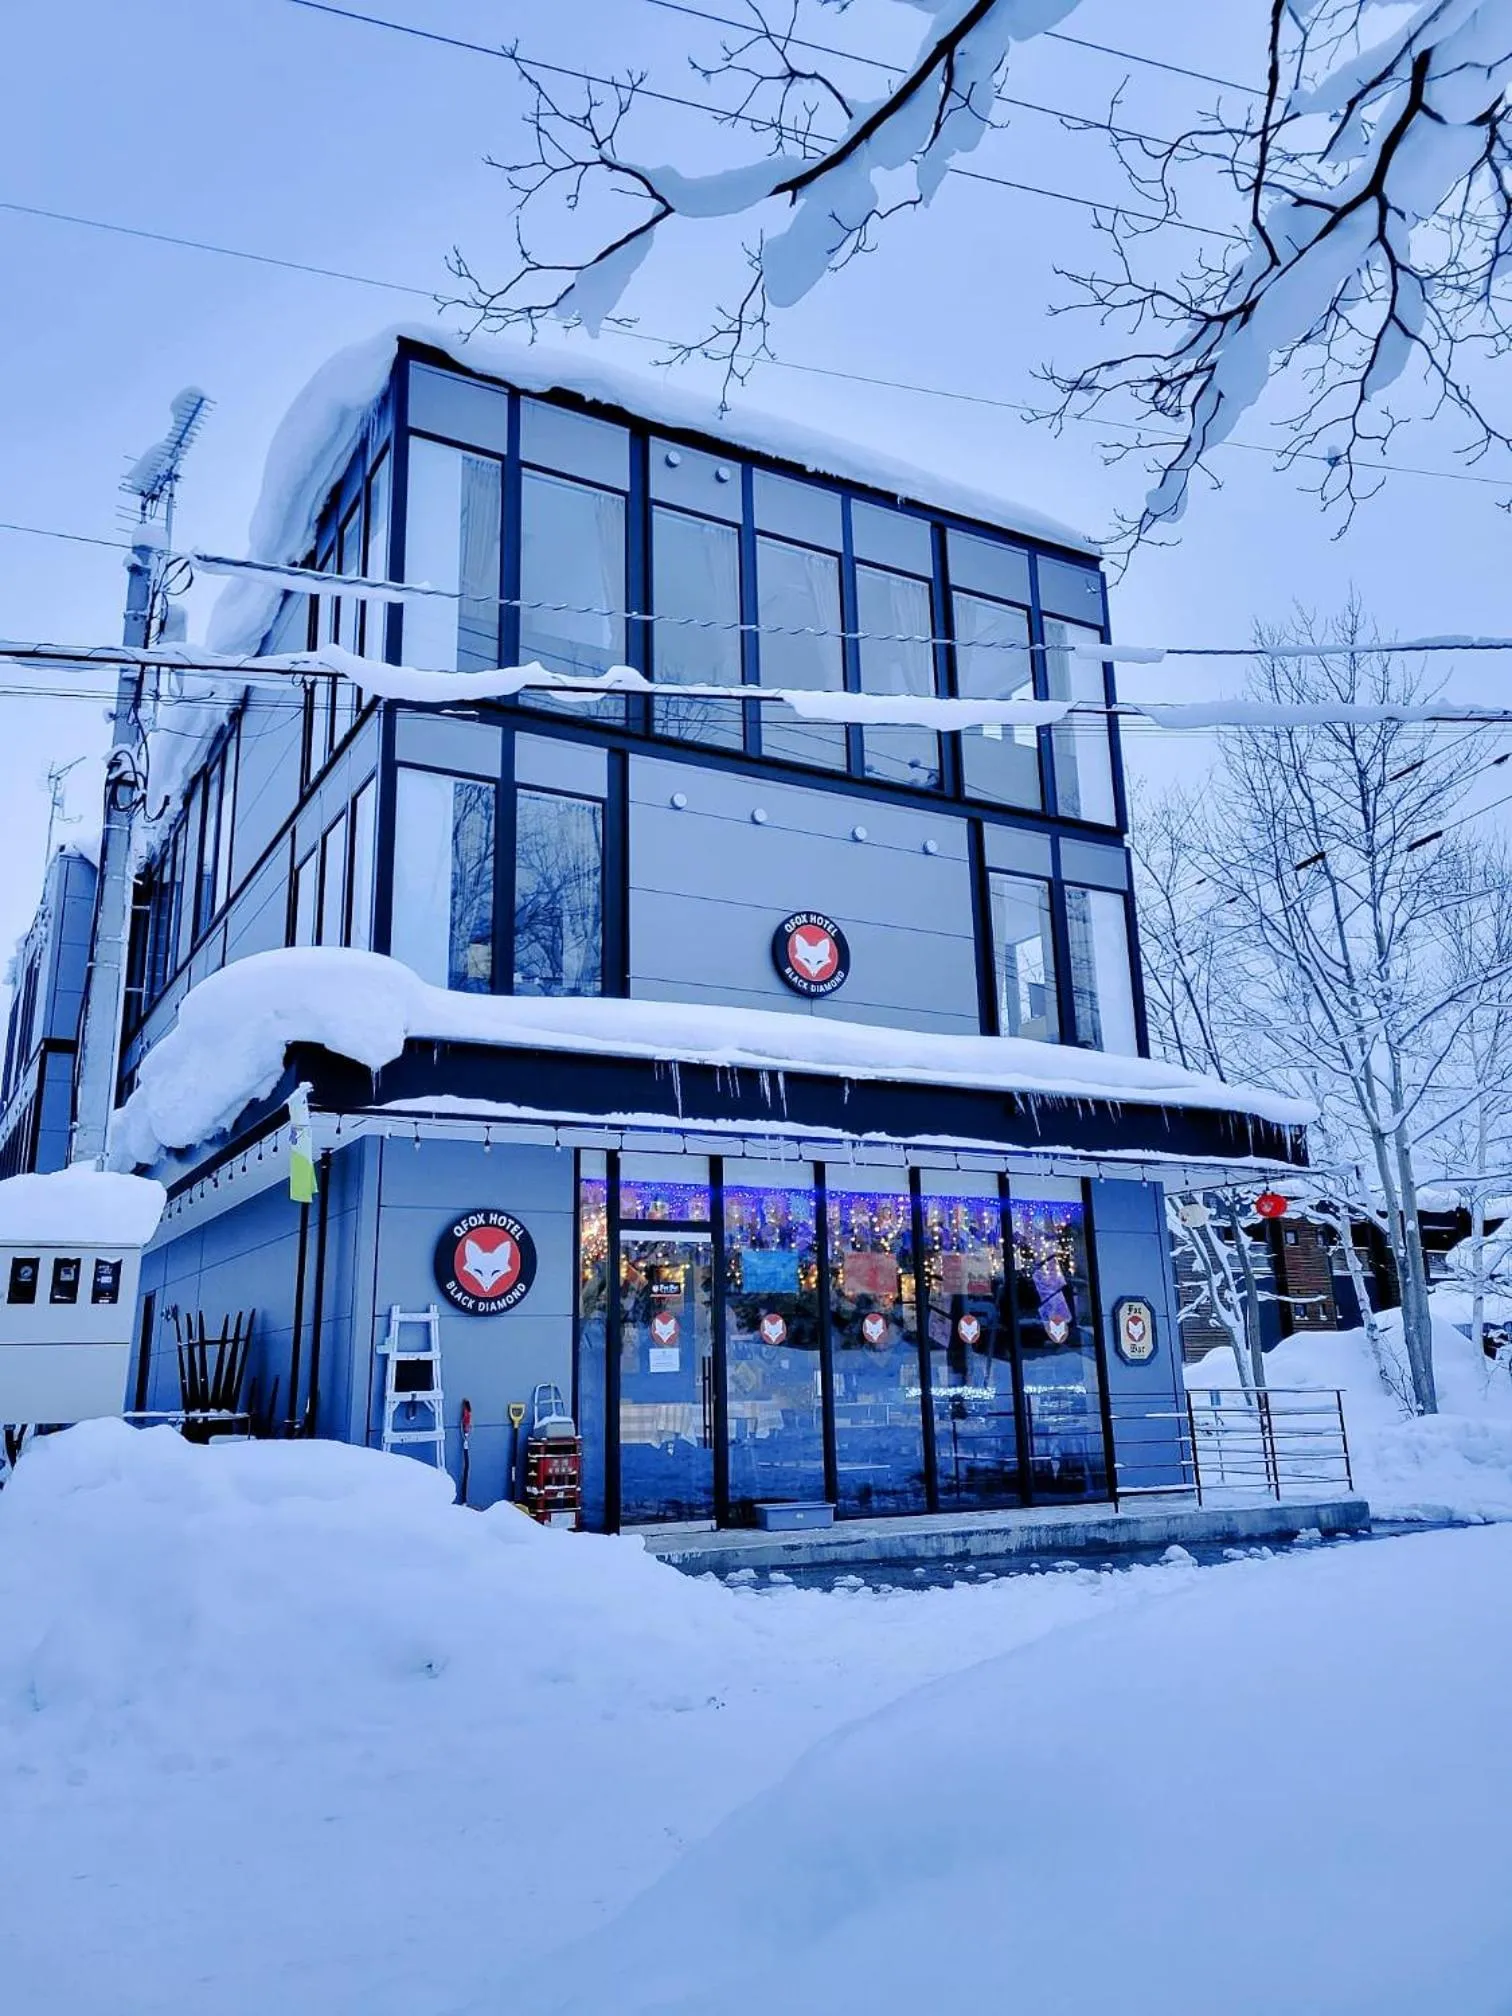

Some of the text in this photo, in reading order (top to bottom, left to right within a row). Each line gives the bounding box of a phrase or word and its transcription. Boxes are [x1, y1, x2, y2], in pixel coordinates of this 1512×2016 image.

[784, 913, 839, 938] QFOX HOTEL
[784, 967, 845, 993] BLACK DIAMOND
[453, 1212, 525, 1241] QFOX HOTEL
[445, 1280, 527, 1312] BLACK DIAMOND
